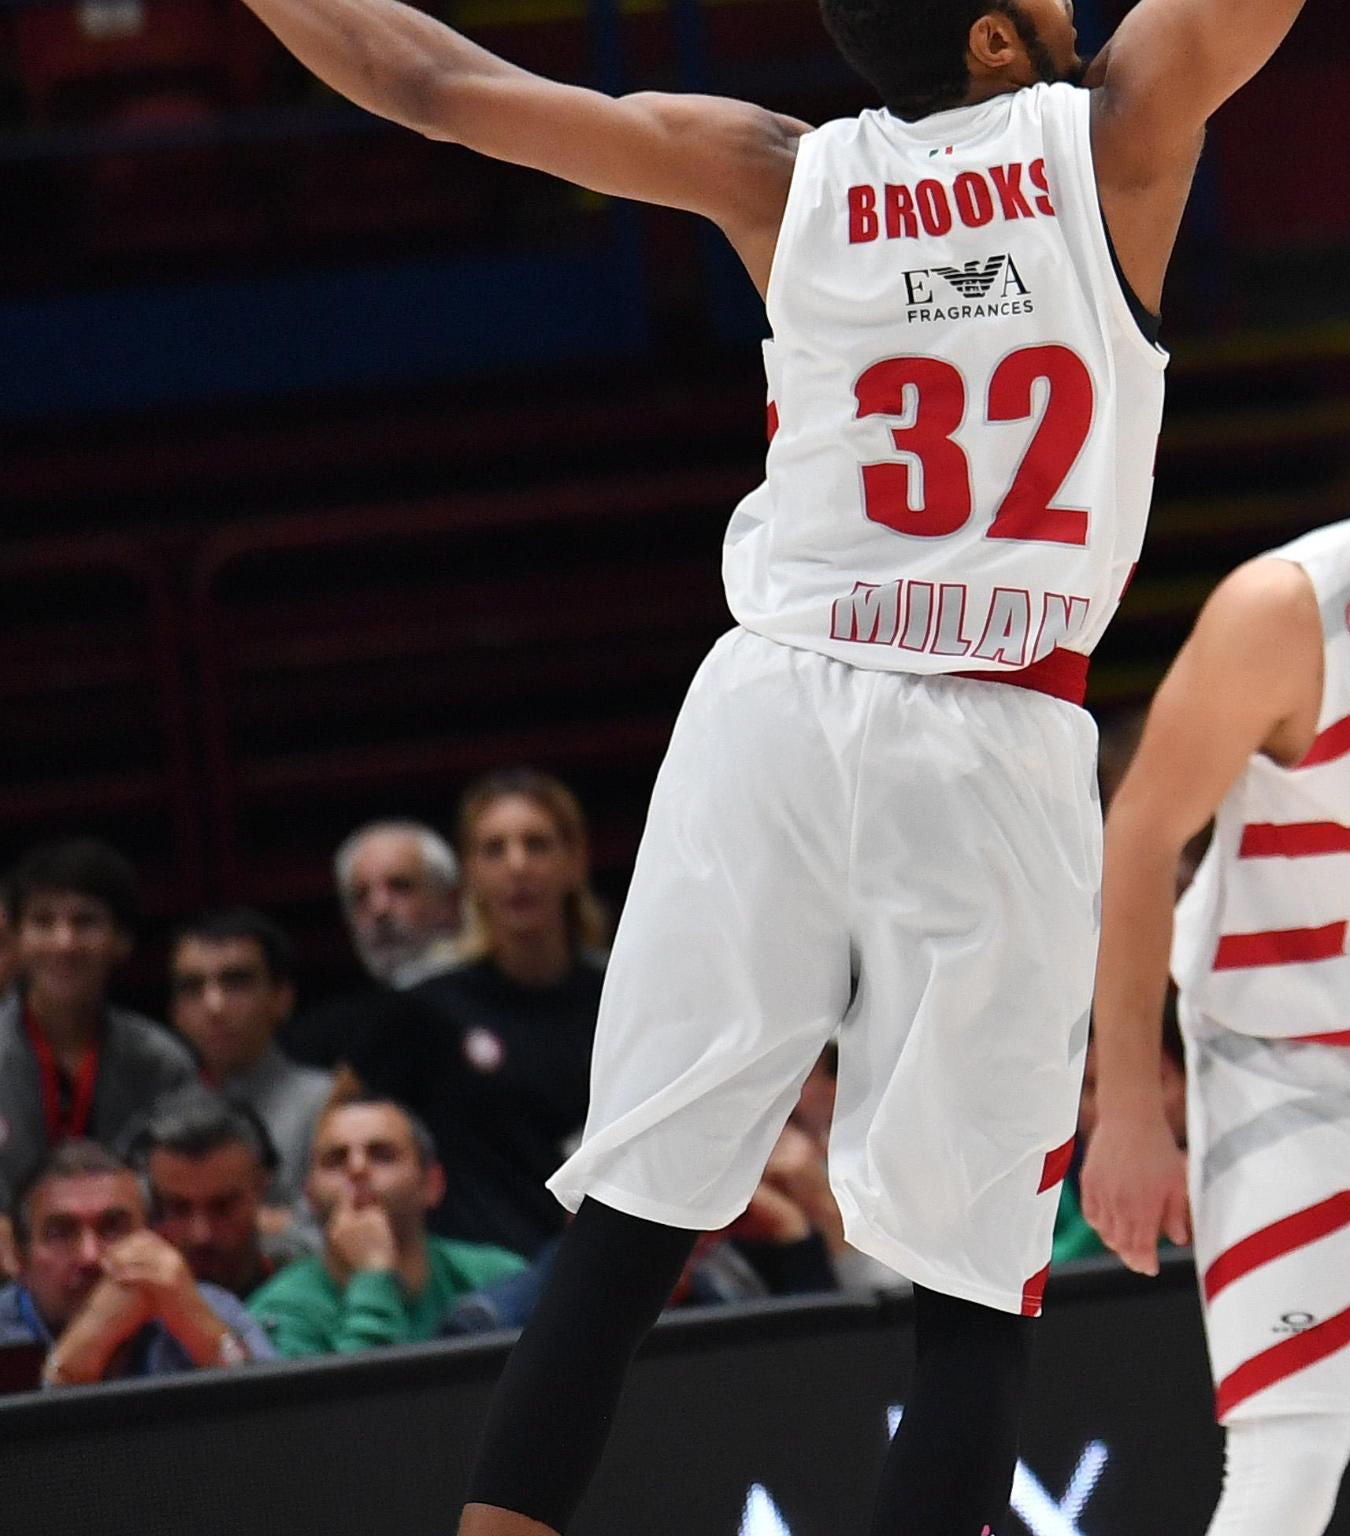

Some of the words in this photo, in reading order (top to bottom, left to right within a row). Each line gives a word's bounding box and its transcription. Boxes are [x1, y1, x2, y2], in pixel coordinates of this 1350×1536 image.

[848, 158, 1056, 244] BROOKS
[907, 300, 1034, 323] FRAGRANCES
[853, 342, 1095, 548] 32
[830, 579, 1090, 666] MILAN
